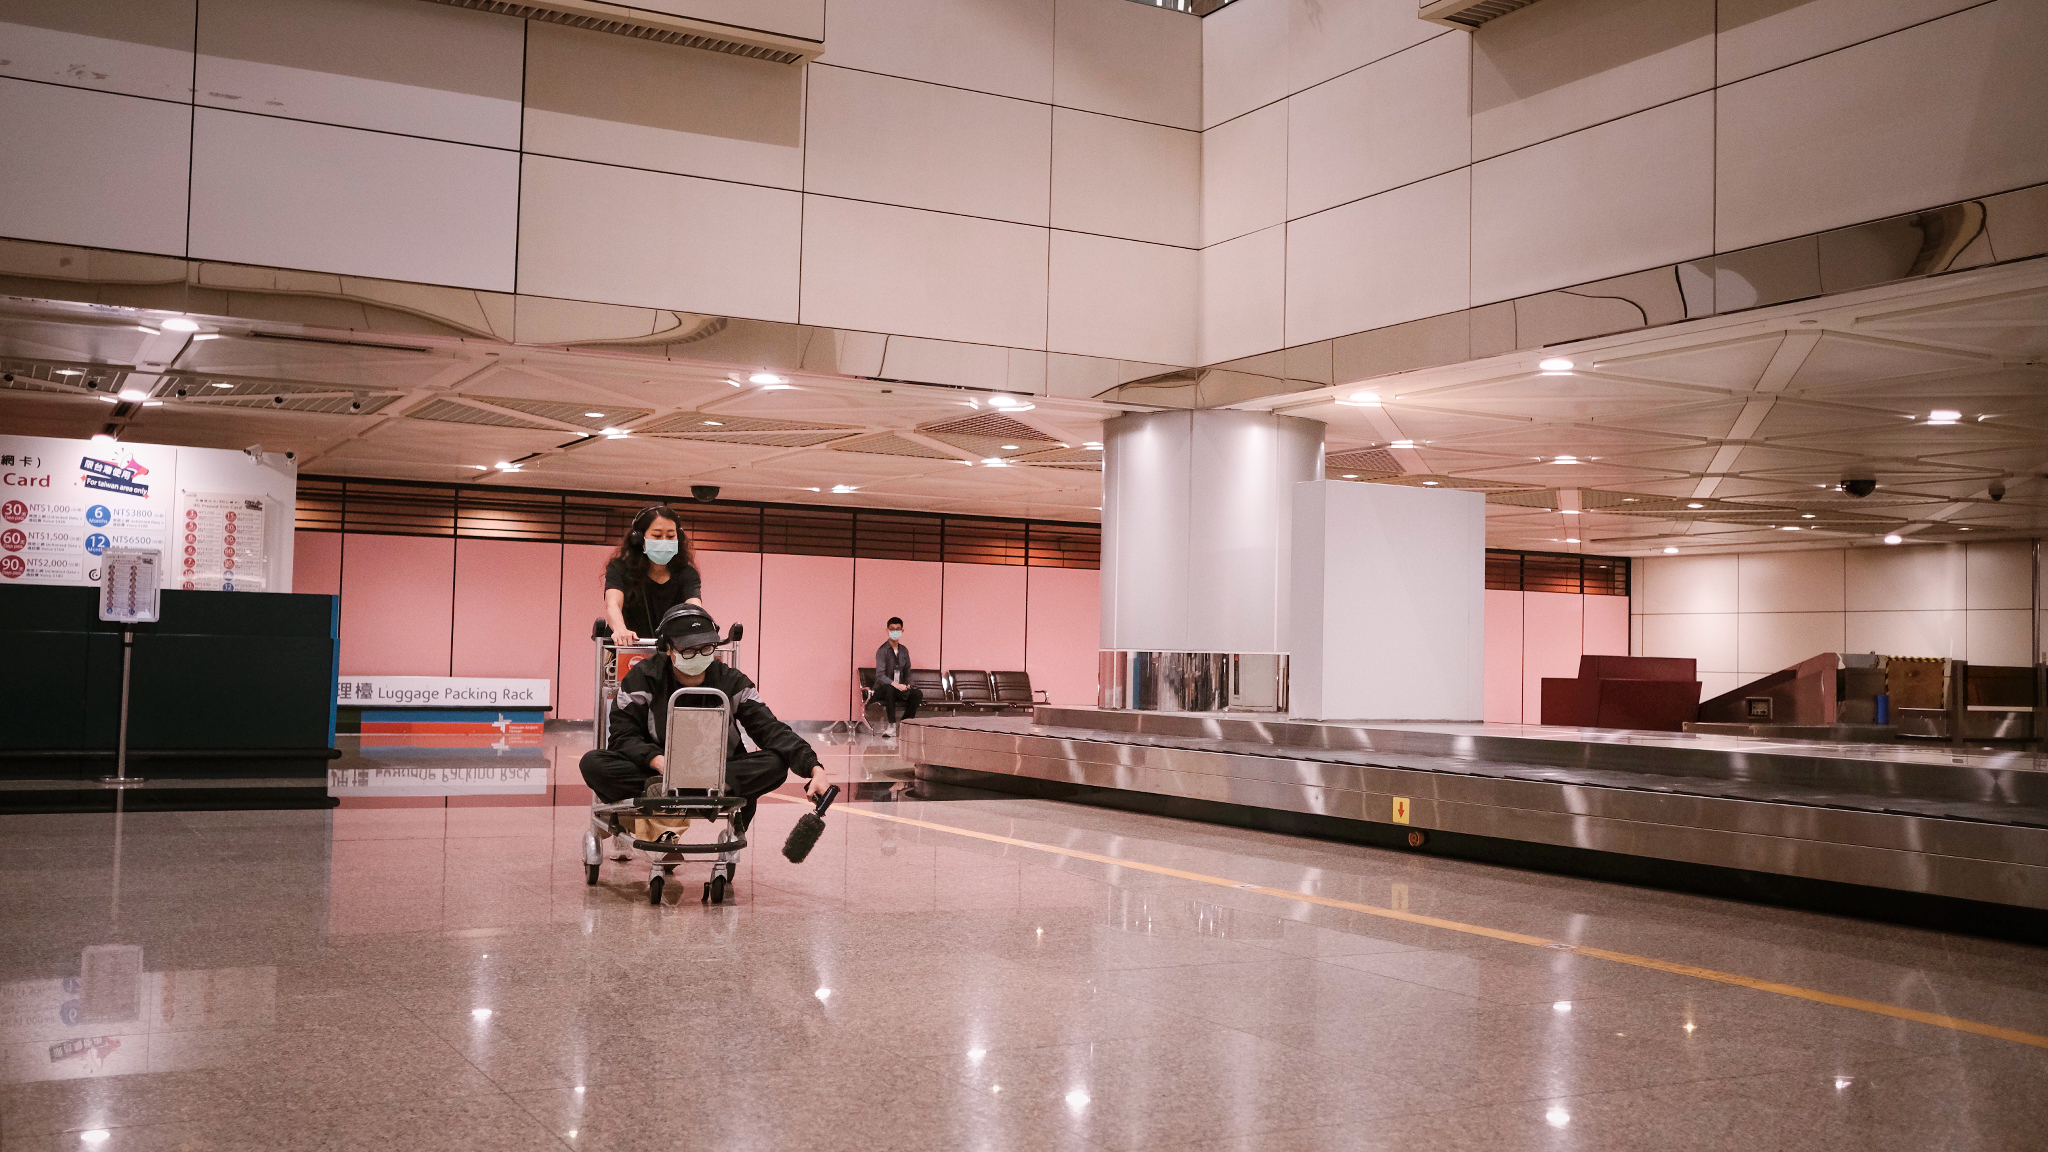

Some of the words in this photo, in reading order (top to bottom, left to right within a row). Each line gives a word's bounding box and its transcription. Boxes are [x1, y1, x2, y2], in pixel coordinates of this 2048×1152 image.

[4, 473, 51, 488] Card
[86, 478, 98, 486] For
[98, 479, 119, 490] taiwan
[119, 483, 134, 493] area
[133, 485, 148, 496] only
[4, 503, 22, 516] 30
[29, 504, 70, 513] NT$1,000
[94, 507, 103, 518] 6
[113, 508, 153, 518] NT$3800
[3, 532, 21, 544] 60
[28, 532, 69, 541] NT$1,500
[90, 536, 105, 547] 12
[112, 535, 151, 544] NT$6500
[2, 558, 19, 570] 90
[27, 558, 68, 568] NT$2,000
[379, 687, 439, 702] Luggage
[445, 687, 497, 703] Packing
[503, 688, 533, 700] Rack
